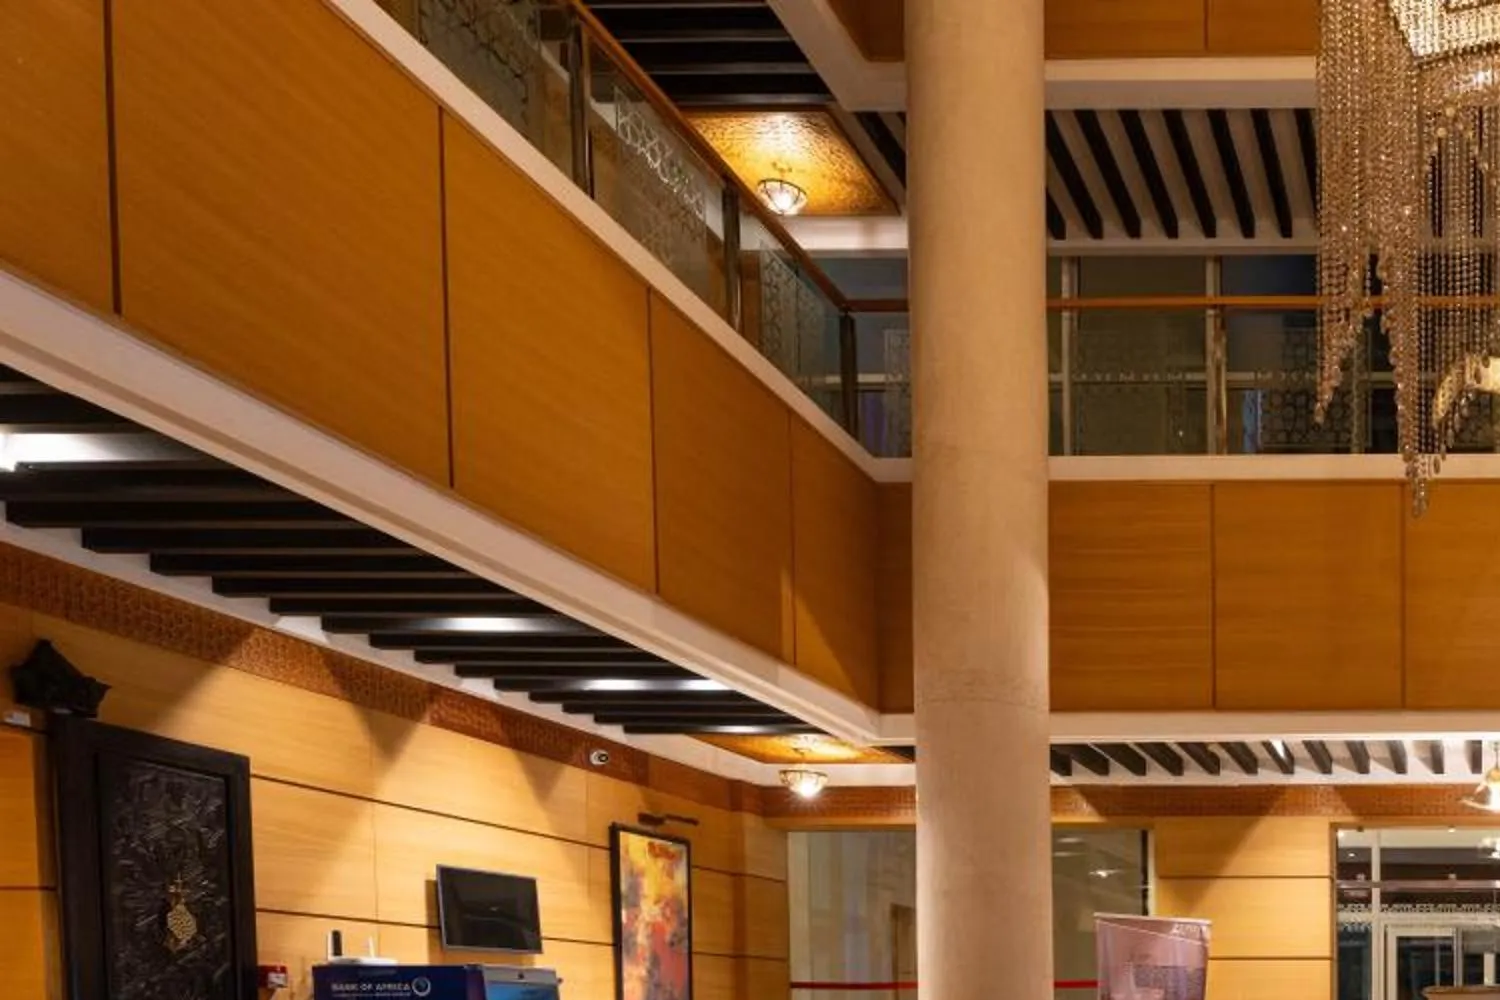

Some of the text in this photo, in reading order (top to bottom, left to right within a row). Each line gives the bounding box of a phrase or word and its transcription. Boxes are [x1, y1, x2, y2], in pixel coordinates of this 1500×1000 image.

[331, 983, 411, 991] BANK OF AFRICA
